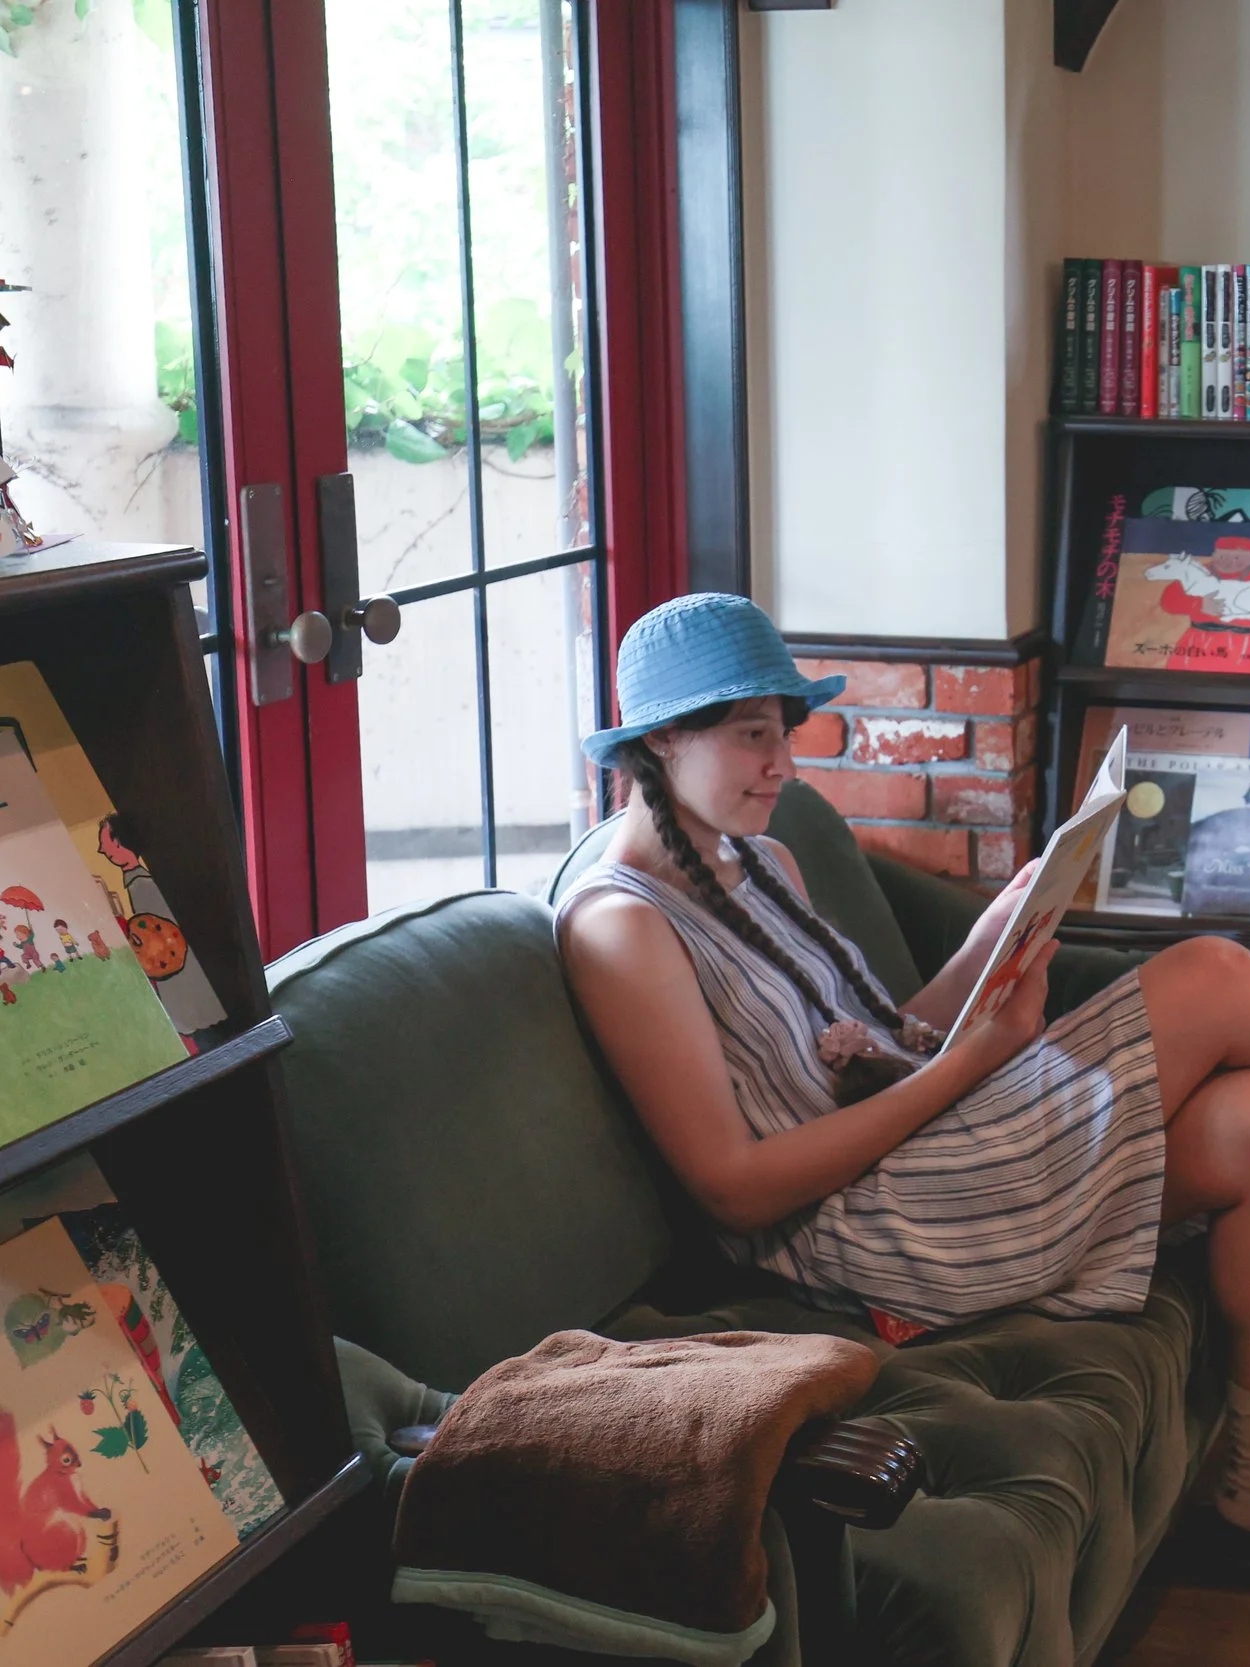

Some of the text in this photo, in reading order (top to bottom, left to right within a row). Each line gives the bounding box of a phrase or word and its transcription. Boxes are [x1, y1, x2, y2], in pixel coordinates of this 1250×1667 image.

[1095, 494, 1126, 599] モチモチの木
[1134, 642, 1228, 658] スーホの白い馬
[1126, 757, 1156, 768] THE
[1202, 858, 1244, 875] Miss
